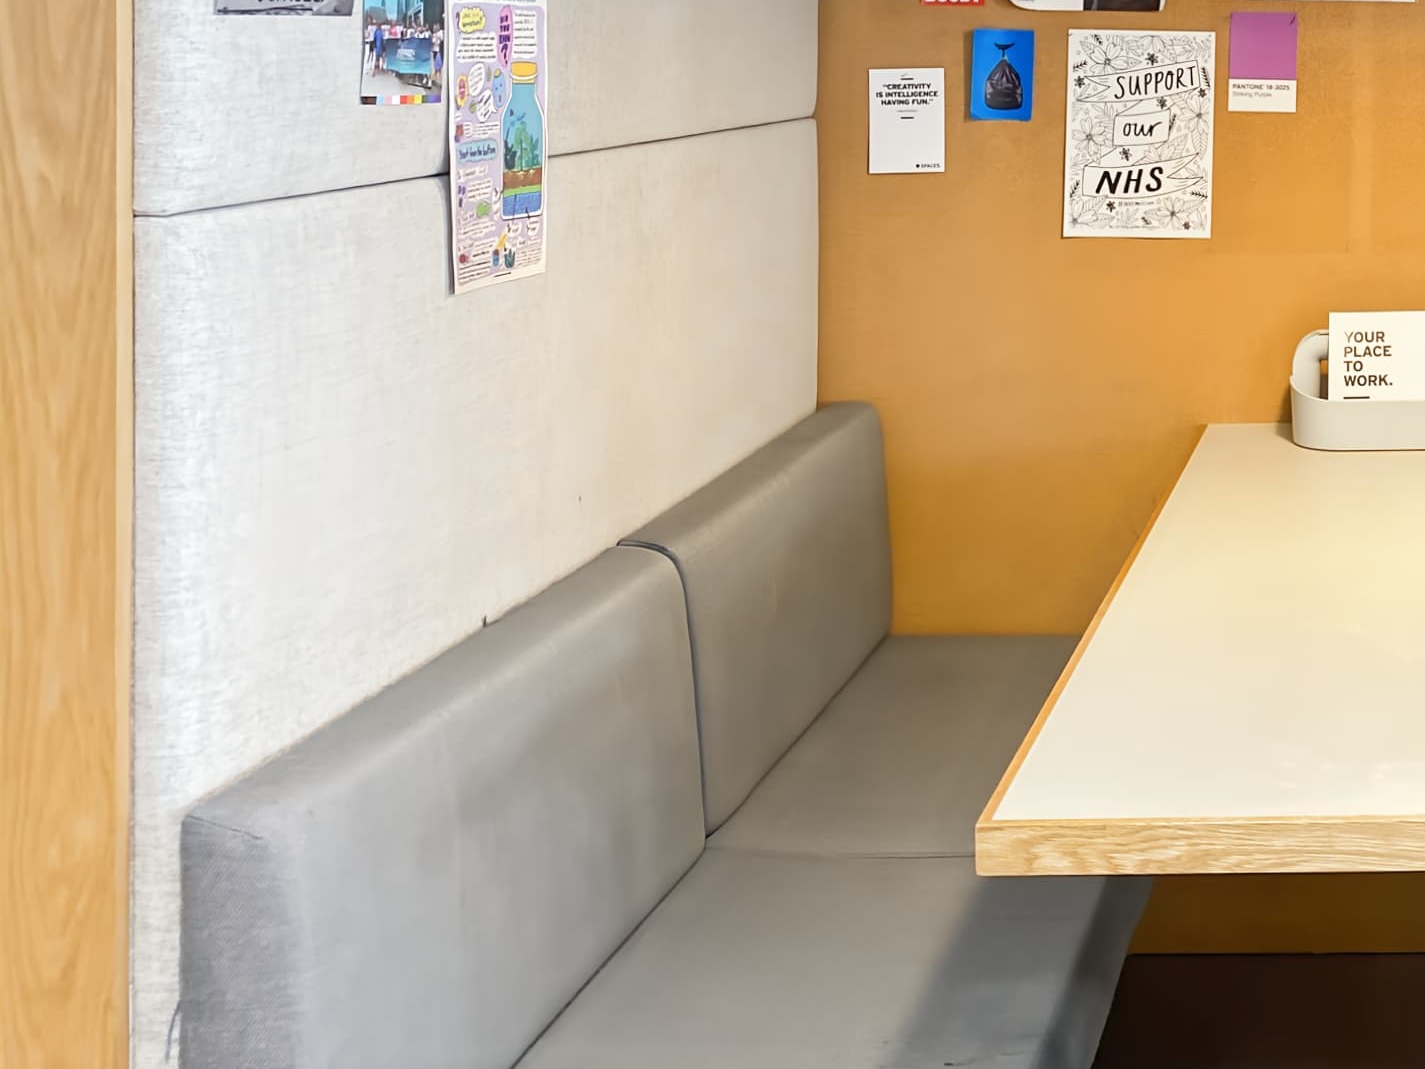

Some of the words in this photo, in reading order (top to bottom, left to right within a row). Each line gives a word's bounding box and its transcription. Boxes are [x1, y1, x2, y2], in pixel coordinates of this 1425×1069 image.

[1114, 66, 1196, 99] SUPPORT
[1122, 122, 1163, 137] our
[1095, 167, 1164, 195] NHS
[1344, 331, 1385, 343] YOUR
[1344, 346, 1392, 358] PLACE
[1344, 360, 1363, 372] TO
[1344, 375, 1393, 387] WORK.
